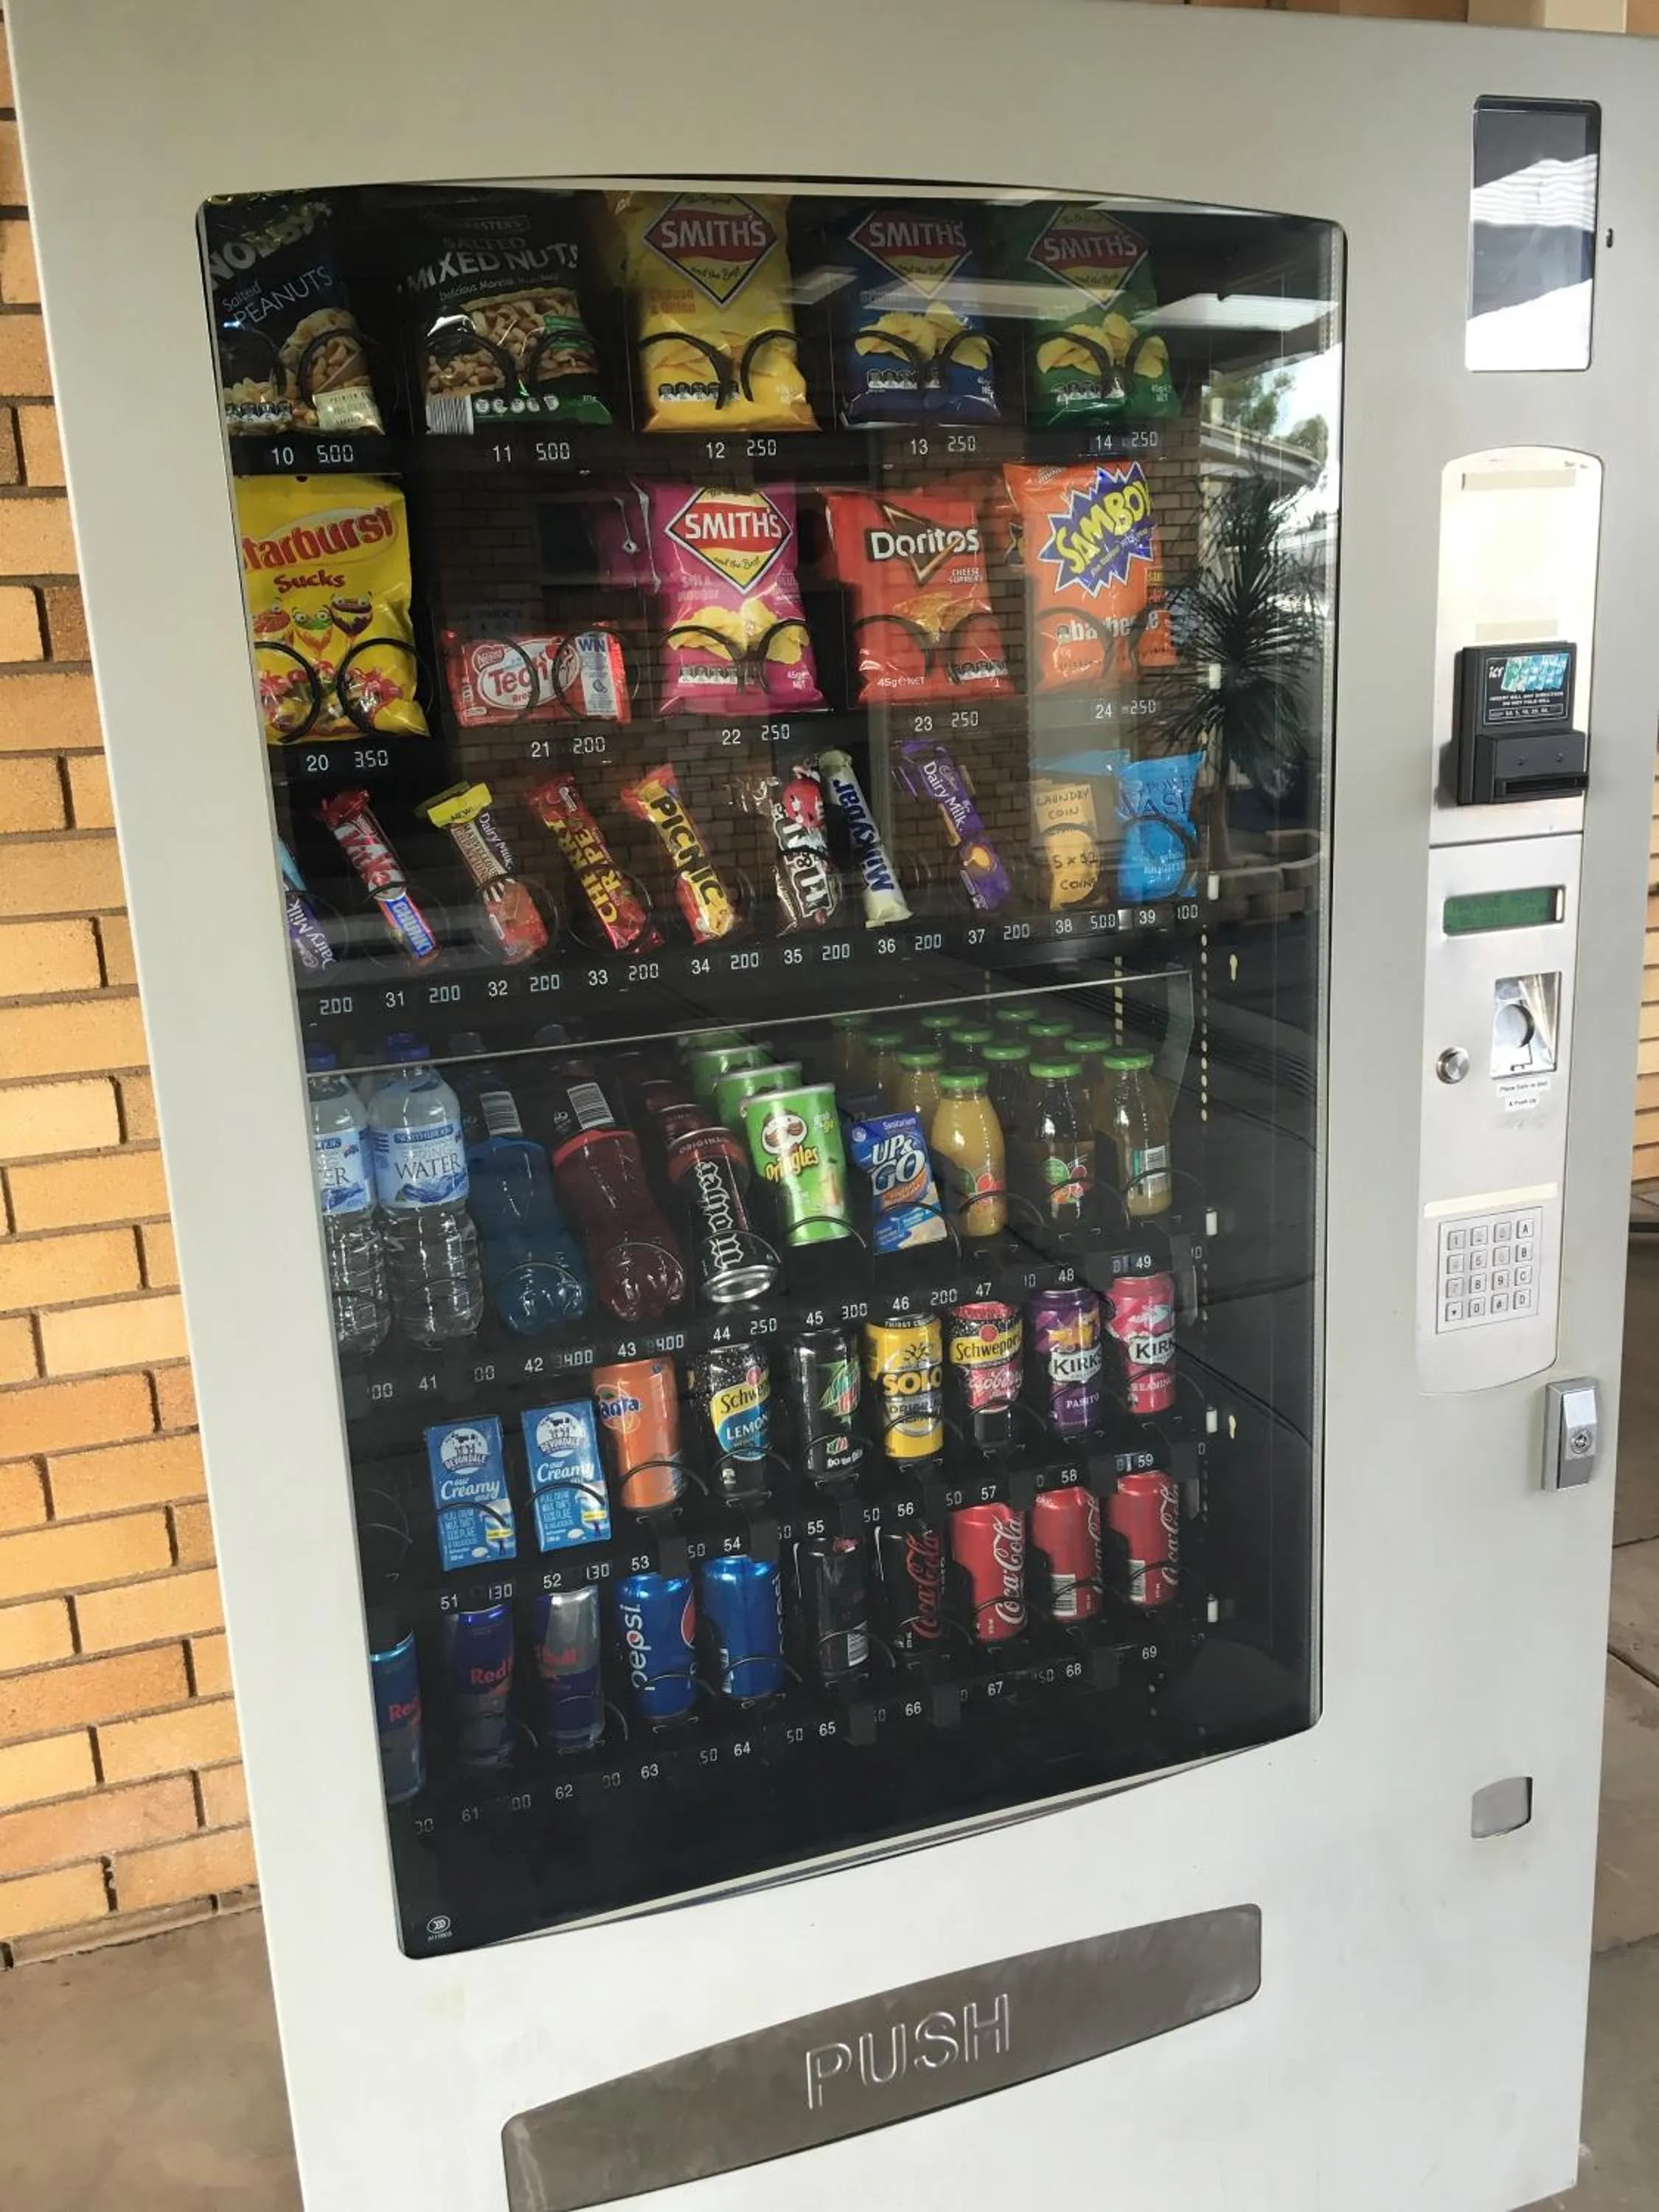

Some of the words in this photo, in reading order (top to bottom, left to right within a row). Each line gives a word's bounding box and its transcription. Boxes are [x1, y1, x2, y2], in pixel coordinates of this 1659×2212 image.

[661, 212, 768, 248] SMITH'S
[1043, 227, 1139, 263] SMITH'S
[406, 249, 498, 293] MIXED
[237, 265, 334, 329] PEANUTS
[706, 442, 726, 459] 12
[911, 439, 928, 455] 13
[1096, 435, 1112, 451] 14
[271, 447, 294, 465] 10
[493, 445, 512, 462] 11
[684, 508, 783, 540] SMITH'S
[240, 505, 394, 571] tarburst
[871, 528, 980, 560] Doritos
[274, 571, 345, 593] Sucks
[577, 639, 606, 654] WIN
[1096, 703, 1113, 719] 24
[915, 716, 933, 732] 23
[722, 730, 740, 745] 22
[531, 742, 550, 758] 21
[307, 755, 329, 771] 20
[922, 760, 950, 799] Dairy
[945, 796, 964, 832] Milk
[479, 813, 499, 846] Dairy
[649, 793, 726, 905] PICNIC
[571, 828, 622, 895] RPE
[1140, 910, 1155, 925] 39
[1055, 919, 1073, 934] 38
[968, 929, 986, 944] 37
[878, 939, 896, 954] 36
[784, 949, 803, 964] 35
[691, 959, 711, 974] 34
[588, 970, 608, 987] 33
[488, 981, 508, 998] 32
[386, 992, 405, 1008] 31
[394, 1153, 462, 1180] WATER
[871, 1150, 926, 1194] GO
[1136, 1256, 1152, 1270] 49
[1058, 1268, 1074, 1283] 48
[975, 1282, 992, 1297] 47
[892, 1297, 910, 1310] 46
[806, 1311, 824, 1326] 45
[714, 1326, 731, 1341] 44
[618, 1343, 636, 1357] 43
[524, 1358, 544, 1373] 42
[418, 1375, 437, 1391] 41
[883, 1369, 943, 1396] SOLO
[599, 1396, 641, 1419] anta
[727, 1413, 768, 1441] LEMON
[1138, 1453, 1155, 1468] 59
[537, 1461, 594, 1483] Creamy
[1060, 1469, 1077, 1484] 58
[441, 1478, 501, 1500] Creamy
[981, 1485, 997, 1500] 57
[897, 1503, 914, 1517] 56
[807, 1520, 824, 1536] 55
[723, 1537, 741, 1554] 54
[631, 1555, 650, 1571] 53
[543, 1573, 562, 1588] 52
[440, 1595, 459, 1610] 51
[618, 1602, 656, 1692] pepsi
[1142, 1645, 1158, 1659] 69
[1065, 1662, 1082, 1677] 68
[988, 1680, 1004, 1696] 67
[905, 1702, 923, 1717] 66
[819, 1721, 836, 1736] 65
[734, 1741, 751, 1757] 64
[641, 1763, 659, 1779] 63
[554, 1784, 573, 1800] 62
[462, 1806, 479, 1822] 61
[805, 1993, 1010, 2110] PUSH
